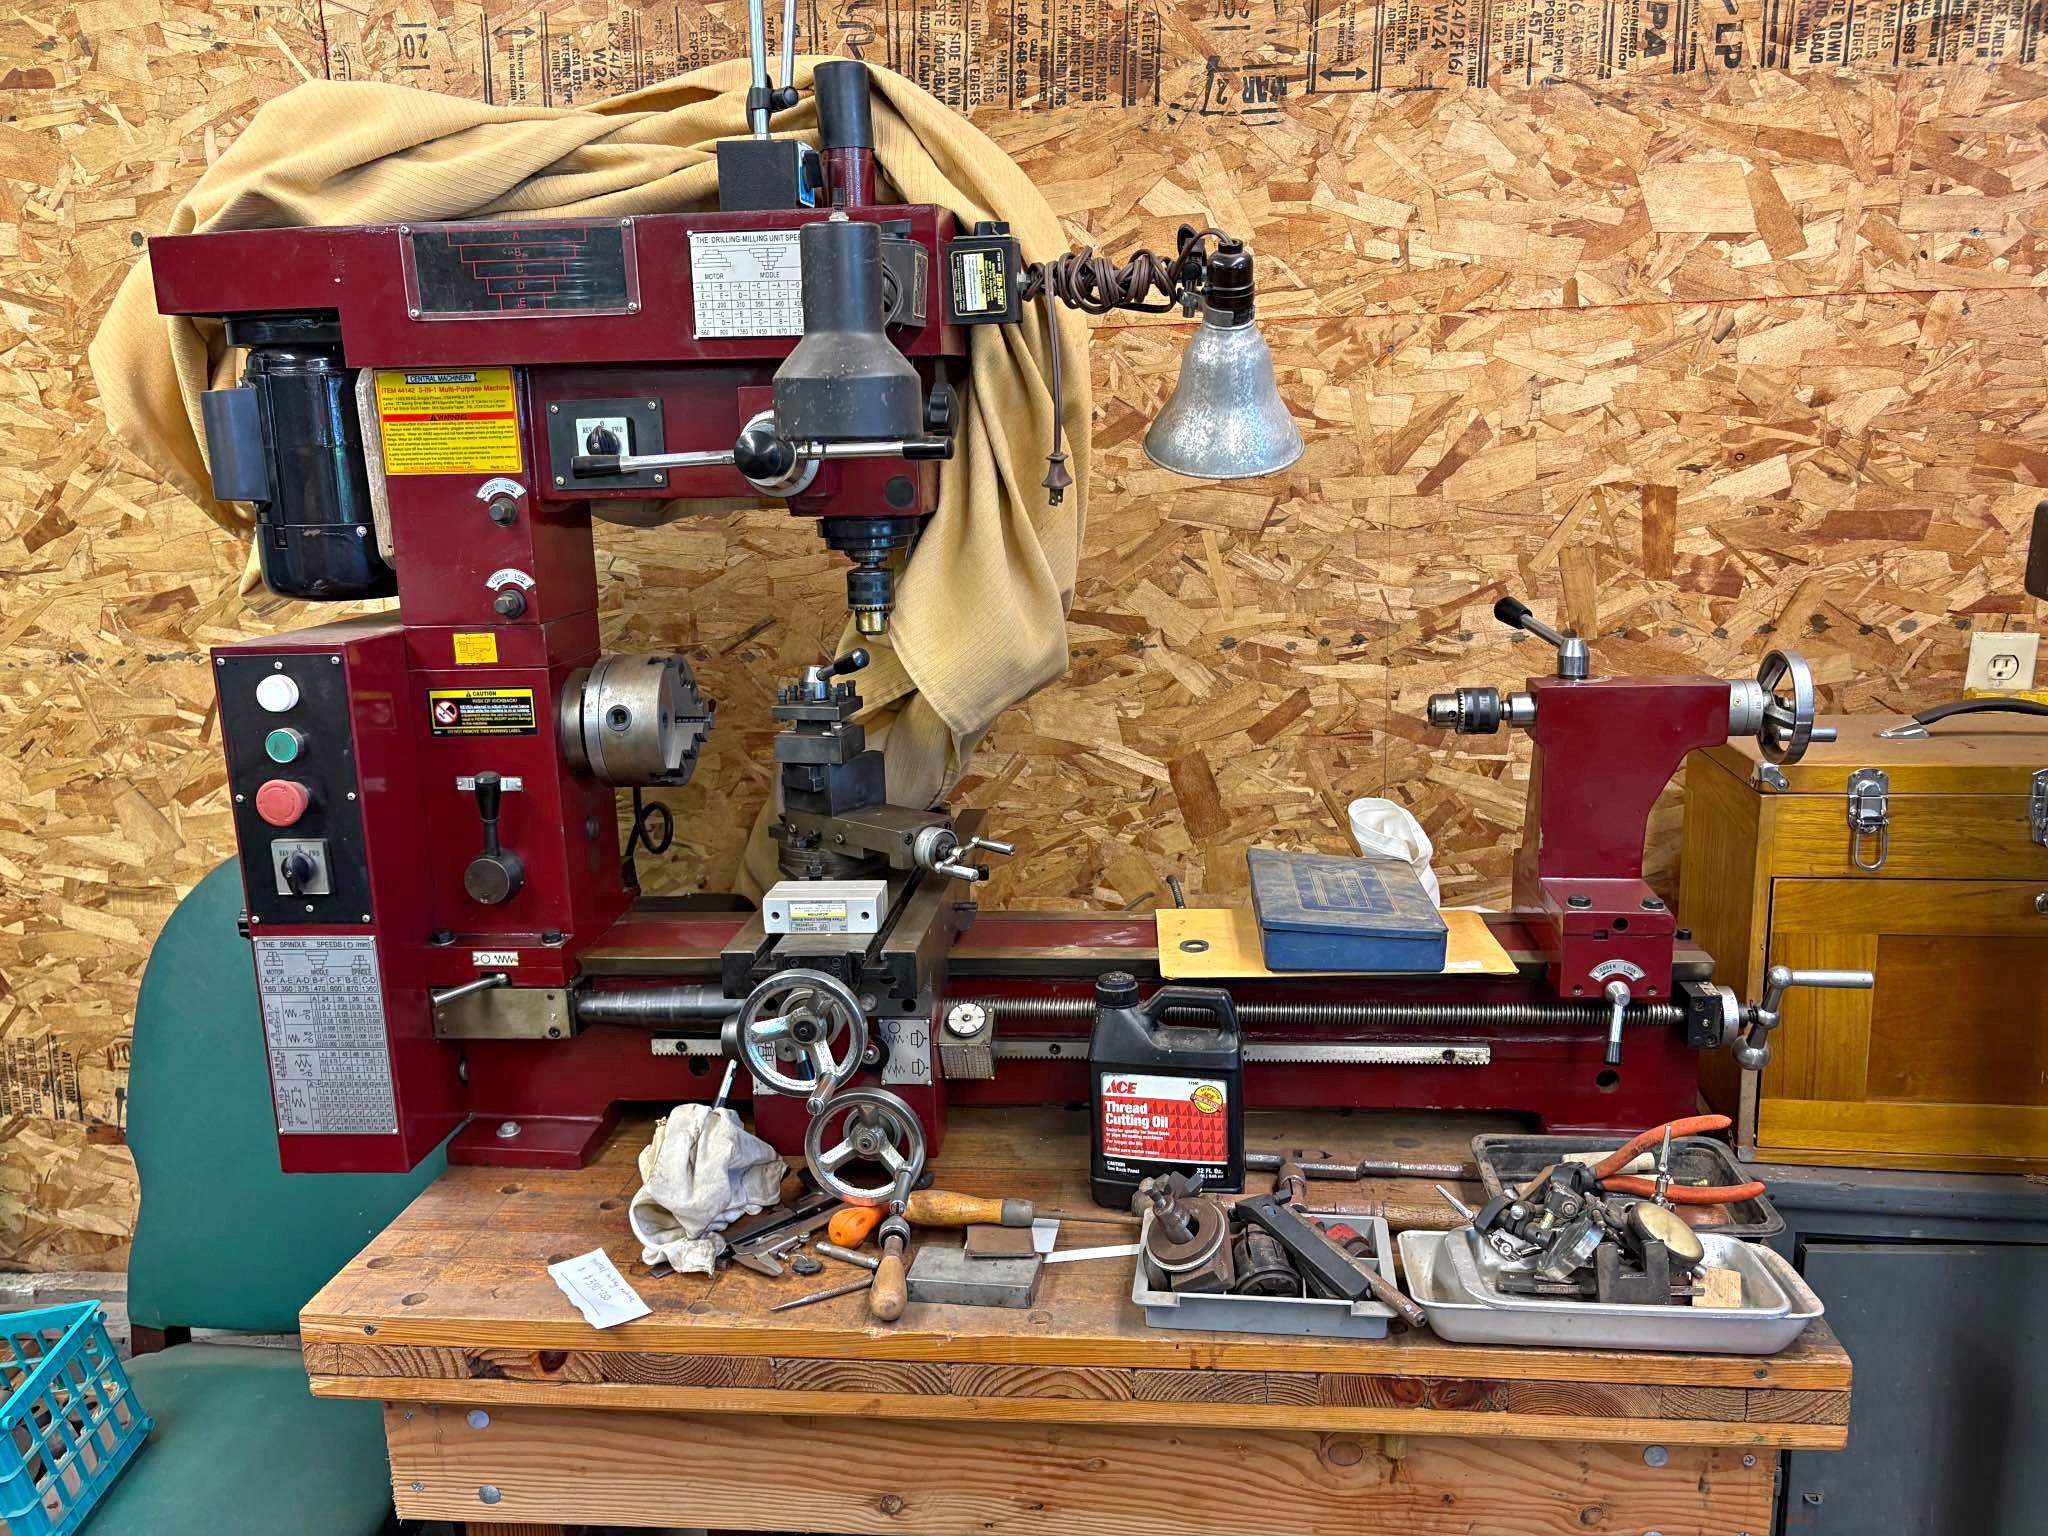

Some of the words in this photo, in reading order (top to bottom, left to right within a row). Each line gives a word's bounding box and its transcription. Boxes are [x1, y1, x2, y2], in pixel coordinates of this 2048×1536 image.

[919, 6, 931, 38] MADE
[1339, 2, 1347, 19] THIS
[1346, 1, 1357, 41] STRENGTH
[1408, 5, 1420, 25] CSA
[1555, 3, 1567, 23] FOR
[1854, 5, 1867, 20] AT
[1869, 8, 1883, 23] AT
[767, 16, 775, 35] THE
[970, 20, 982, 47] INCH
[1040, 19, 1049, 42] MORE
[1384, 7, 1397, 54] ADHESIVE
[1430, 5, 1450, 51] W24
[1528, 10, 1543, 36] 457
[1794, 9, 1811, 55] CANADA
[1881, 3, 1898, 50] PANELS
[948, 33, 962, 62] SIDE
[1070, 5, 1082, 66] ACCORDANCE
[1336, 22, 1346, 63] DIRECTION
[1407, 28, 1418, 52] 0325
[1513, 17, 1527, 71] SHEATHING
[1714, 20, 1745, 70] LP
[1825, 22, 1845, 63] DOWN
[1850, 23, 1866, 63] EDGES
[1865, 27, 1882, 60] ENDS
[1961, 25, 1976, 49] WITH
[1990, 20, 2007, 58] PANELS
[560, 36, 571, 79] EXTERIOR
[571, 48, 581, 66] CSA
[1015, 2, 1029, 99] 1-800-648-6893
[1055, 15, 1069, 106] RECOMMENDATIONS
[1395, 42, 1406, 66] TYPE
[1502, 23, 1515, 76] HUD-UM-40
[1552, 29, 1566, 74] SPACING
[516, 44, 525, 81] STRENGTH
[551, 50, 562, 93] ADHESIVE
[996, 49, 1008, 94] PANELS
[1082, 39, 1095, 89] INSTALLED
[1466, 38, 1479, 88] SHEATHING
[509, 64, 518, 101] DIRECTION
[573, 69, 582, 92] 0325
[947, 67, 961, 106] DOWN
[969, 68, 981, 106] EDGES
[1069, 70, 1080, 93] WITH
[1095, 66, 1107, 102] PANELS
[1242, 75, 1288, 104] MAR
[563, 83, 573, 105] TYPE
[696, 236, 709, 244] THE
[711, 234, 768, 244] DRILLING-MILLING
[770, 234, 784, 242] UNIT
[514, 247, 523, 257] B
[516, 263, 525, 275] C
[704, 272, 725, 280] MOTOR
[759, 271, 780, 279] MIDDLE
[518, 280, 527, 290] D
[519, 297, 528, 308] E
[382, 386, 397, 394] ITEM
[438, 384, 482, 393] Multi-Purpose
[483, 383, 511, 392] Machine
[410, 374, 437, 383] CENTRAL
[438, 373, 472, 382] MACHINERY
[481, 482, 499, 495] LOOSEN
[504, 482, 517, 491] LOCK
[490, 572, 509, 584] LOOSEN
[514, 573, 527, 582] LOCK
[262, 941, 275, 949] THE
[263, 976, 277, 985] A-F
[279, 976, 293, 985] A-E
[295, 976, 311, 985] A-D
[312, 976, 326, 985] B-F
[328, 976, 343, 985] C-F
[345, 976, 359, 985] B-E
[361, 976, 377, 985] C-D
[265, 968, 285, 976] MOTOR
[1623, 965, 1636, 974] LOCK
[313, 985, 327, 993] 470
[1104, 1079, 1138, 1095] ACE
[1104, 1100, 1148, 1115] Thread
[1104, 1113, 1150, 1129] Cutting
[1151, 1115, 1169, 1128] Oil
[1106, 1160, 1126, 1168] CAUTION
[1196, 1167, 1206, 1175] 32
[1205, 1167, 1213, 1175] Fl.
[1213, 1168, 1224, 1176] Oz.
